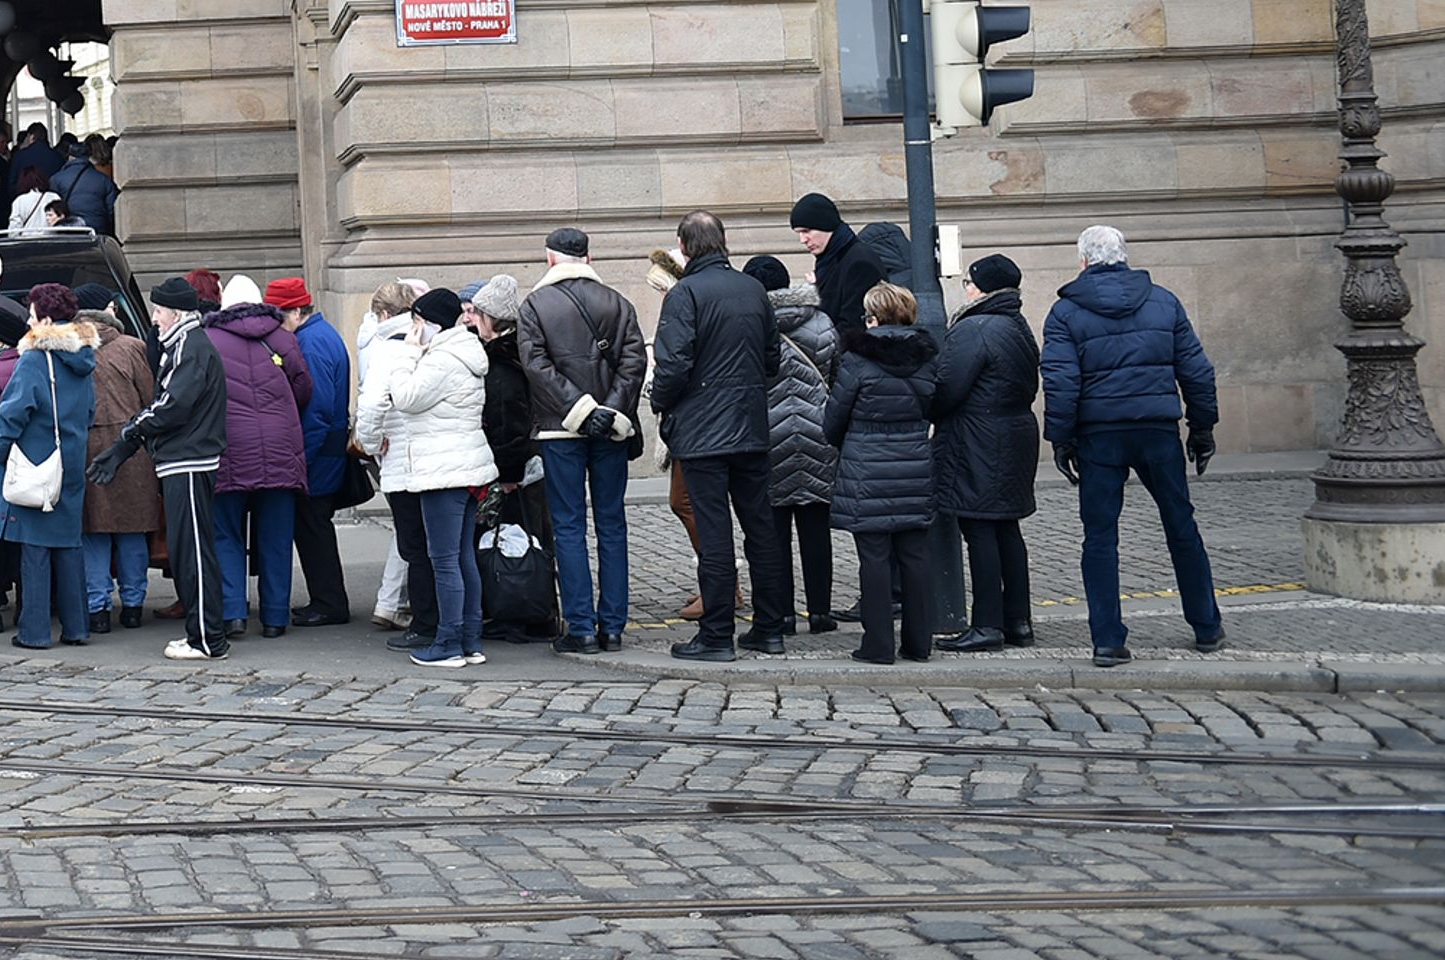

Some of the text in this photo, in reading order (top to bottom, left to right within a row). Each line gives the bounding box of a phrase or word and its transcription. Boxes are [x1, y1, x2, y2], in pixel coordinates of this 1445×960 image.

[405, 2, 467, 19] MASARYKOVO
[408, 21, 431, 32] NOVÉ
[433, 20, 463, 31] MĚSTO
[470, 20, 499, 30] PRAHA
[501, 20, 506, 29] 1
